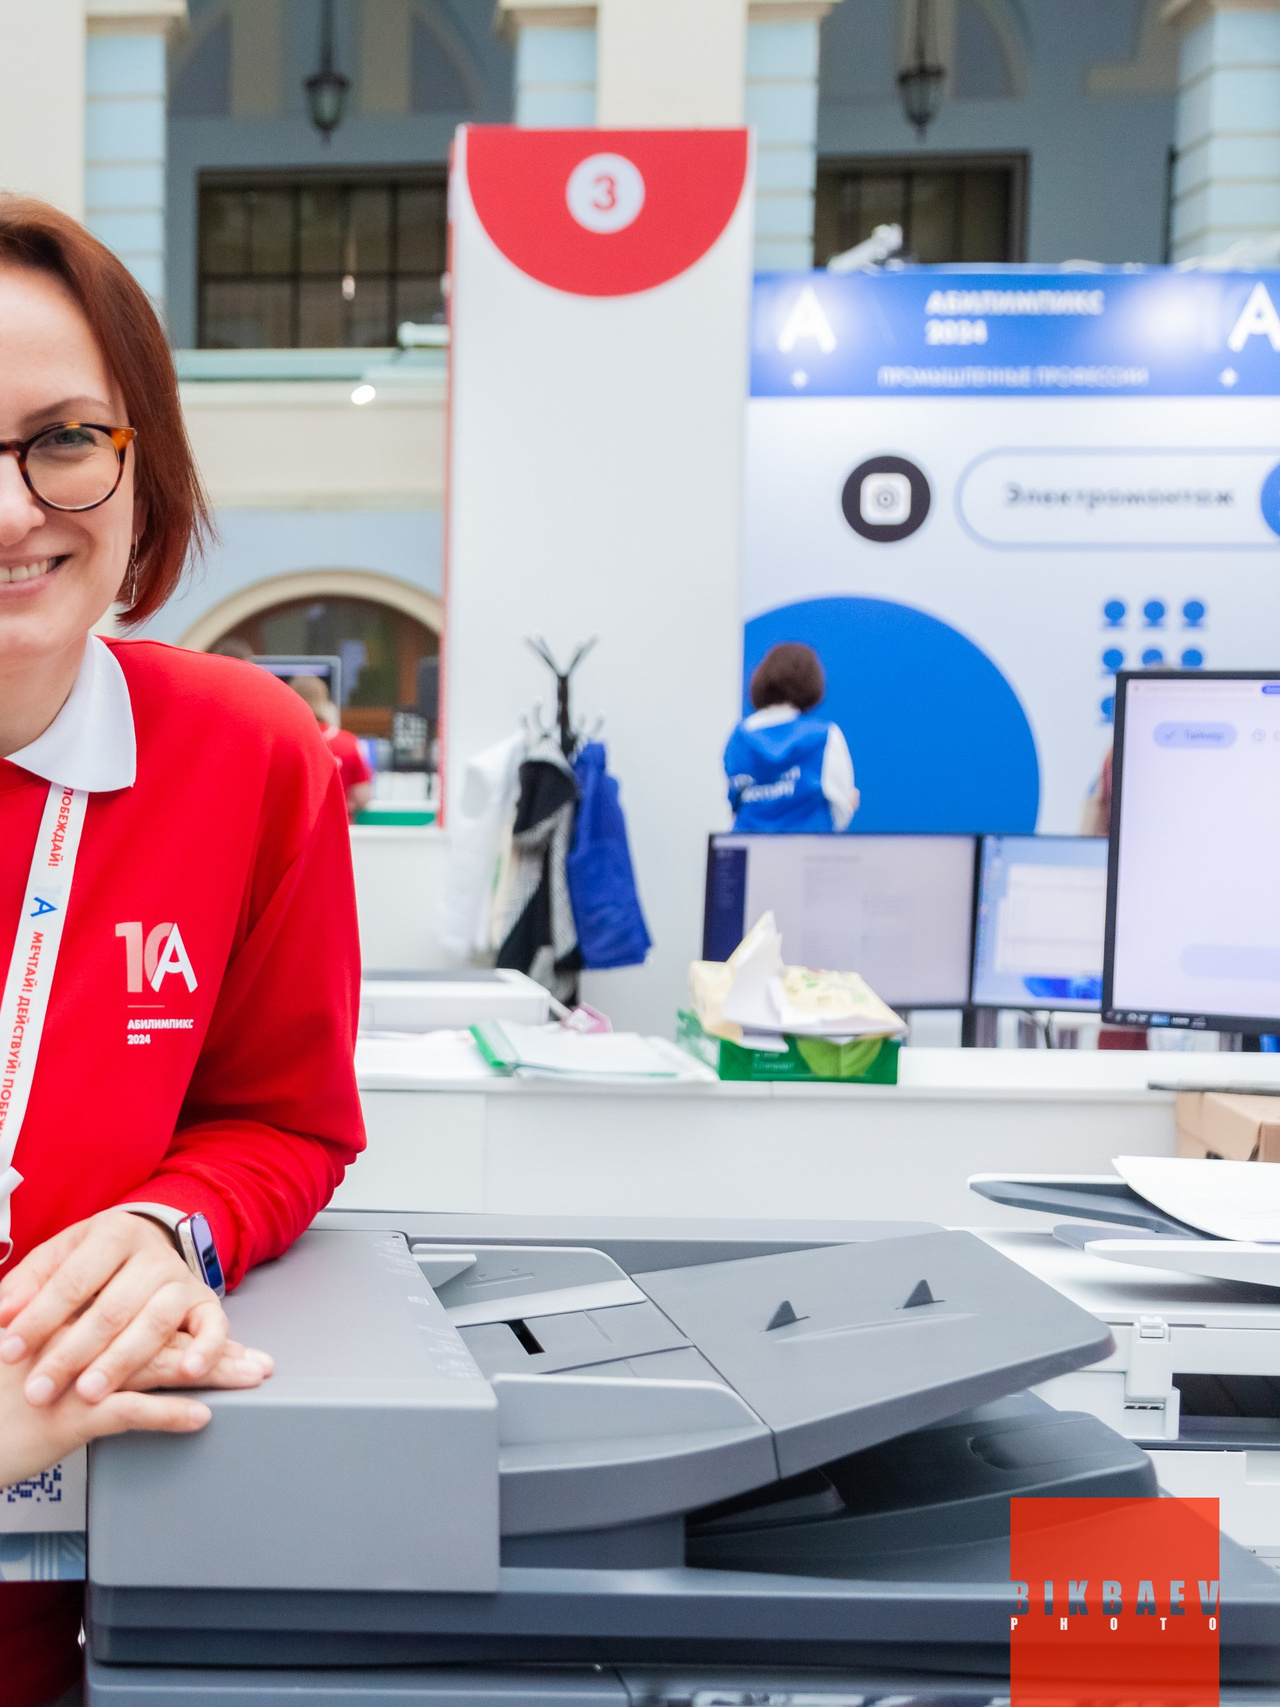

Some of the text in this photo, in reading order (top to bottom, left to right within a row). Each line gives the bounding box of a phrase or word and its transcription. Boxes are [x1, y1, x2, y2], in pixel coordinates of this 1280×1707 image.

[593, 175, 617, 211] 3
[926, 290, 1105, 316] АБИЛИМПИКС
[925, 319, 988, 345] 2024
[47, 786, 75, 867] ПОБЕЖДАЙ!
[21, 931, 45, 993] МЕЧТАЙ!
[5, 995, 31, 1074] ДЕЙСТВУЙ!
[127, 1018, 194, 1031] АБИЛИМПИКС
[127, 1033, 152, 1046] 2024
